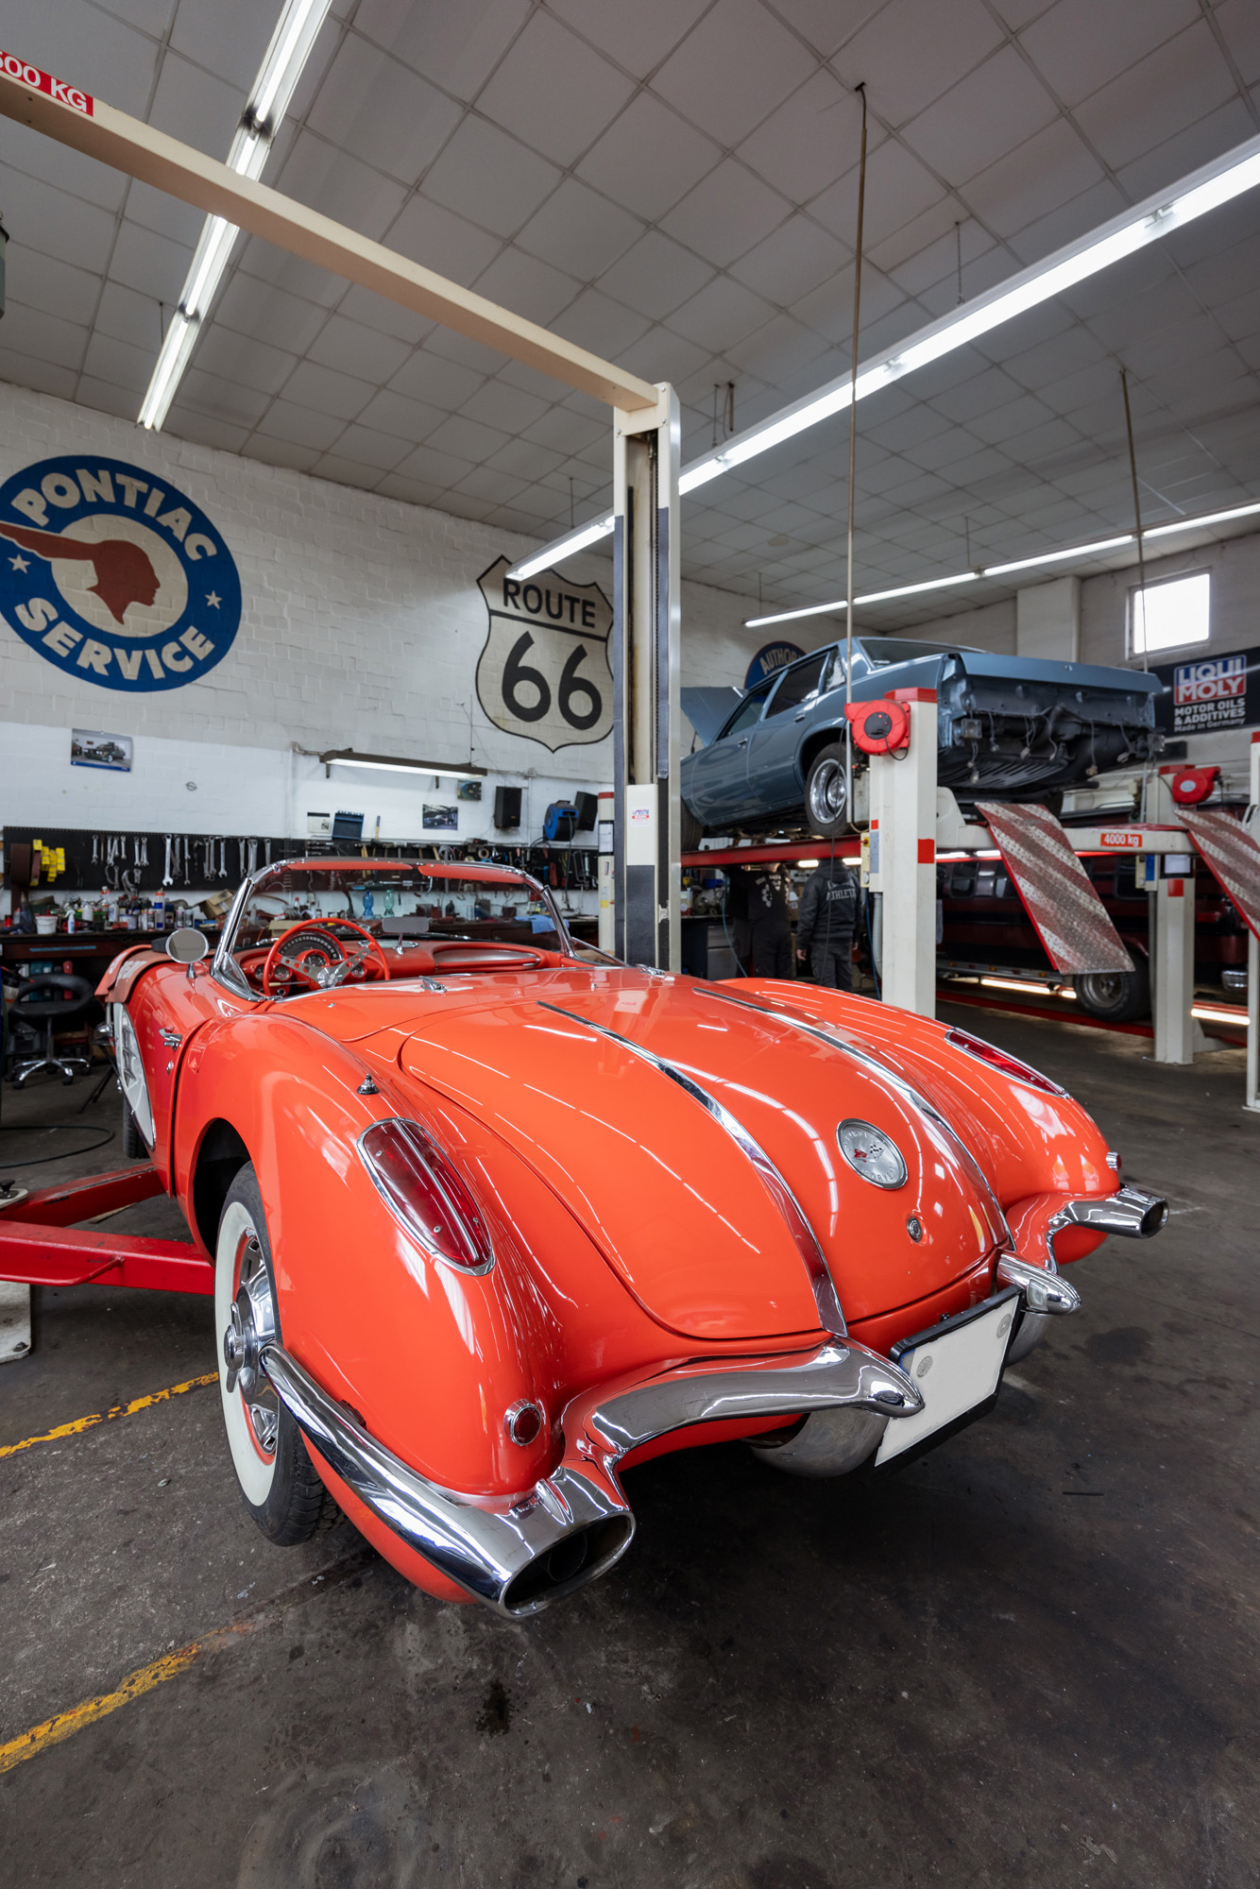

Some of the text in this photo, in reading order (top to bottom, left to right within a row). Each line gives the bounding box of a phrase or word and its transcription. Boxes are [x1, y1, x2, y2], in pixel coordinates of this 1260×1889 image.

[0, 51, 87, 113] 00 KG
[11, 469, 217, 561] PONTIAC
[503, 578, 596, 629] ROUTE
[14, 597, 215, 681] SERVICE
[760, 648, 803, 675] AUTHOR
[1178, 658, 1242, 684] LIQUI
[502, 630, 603, 731] 66
[1178, 676, 1243, 702] MOLY
[1174, 697, 1246, 717] MOTOR OILS
[1174, 707, 1246, 726] & ADDITIVES
[1174, 717, 1246, 733] Made in Germany
[1104, 834, 1139, 847] 4000 kg
